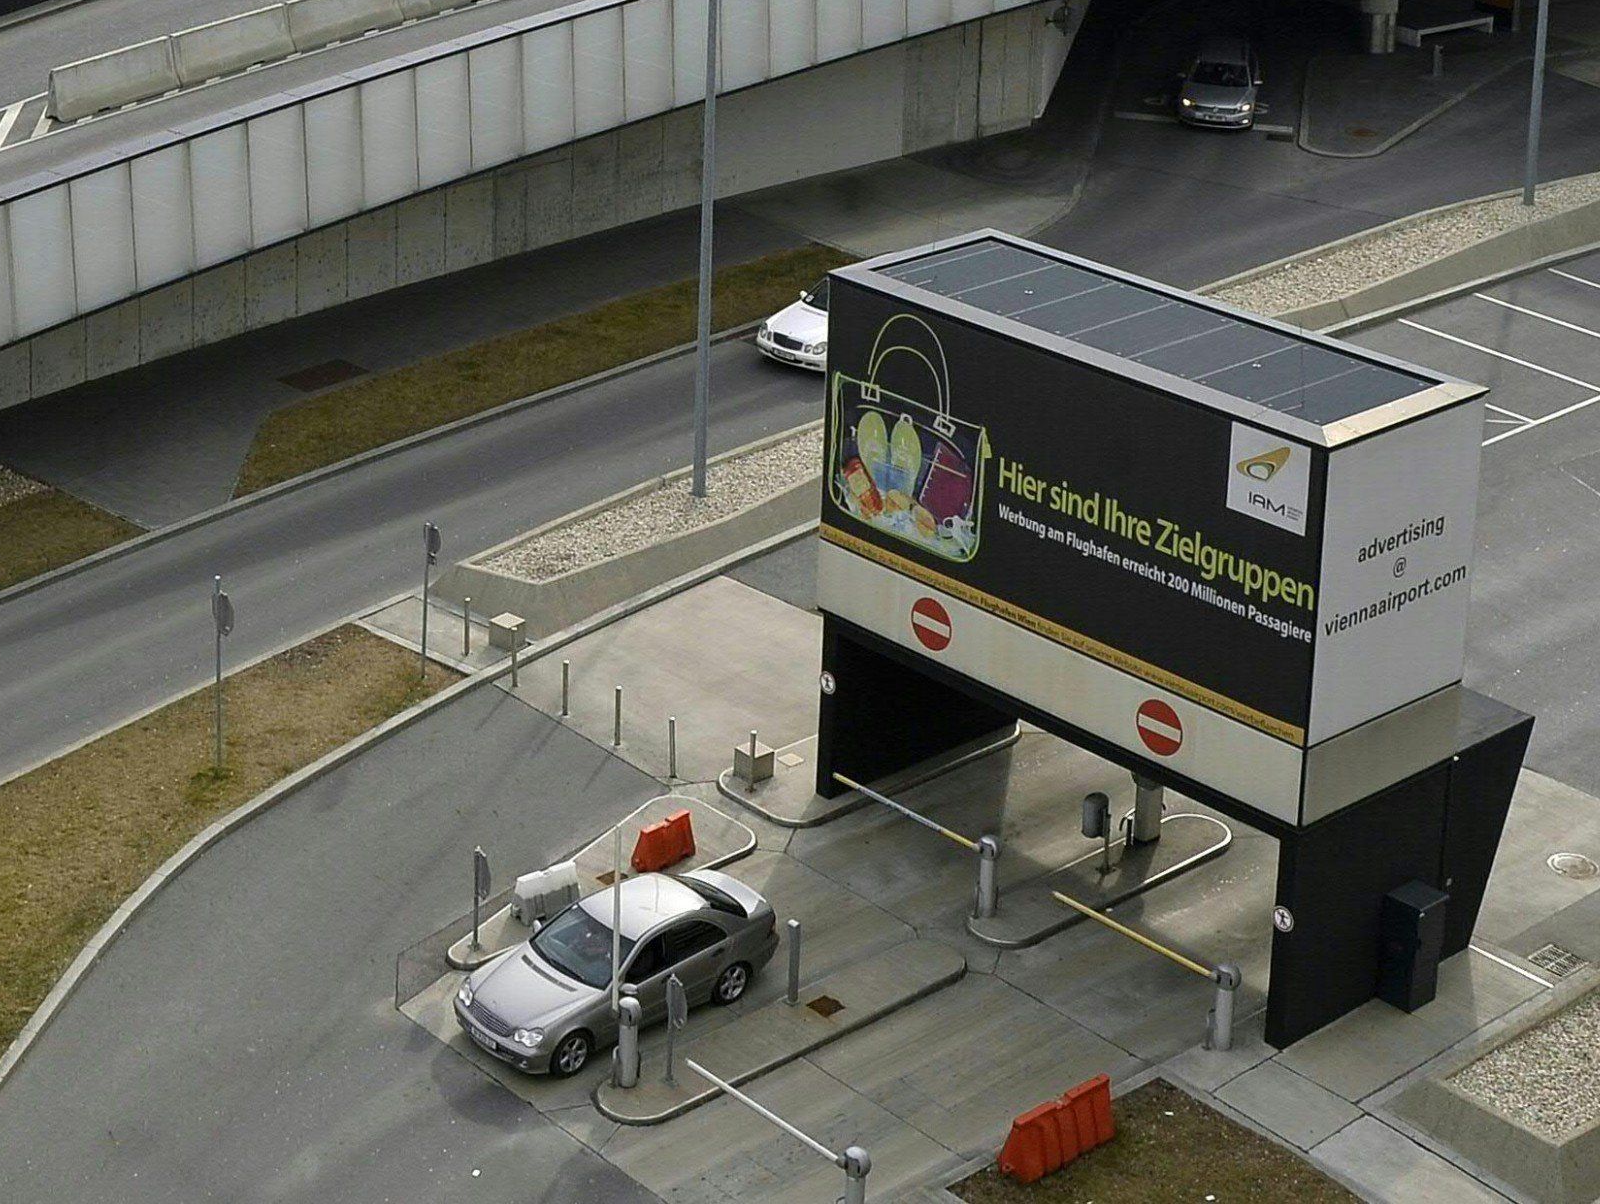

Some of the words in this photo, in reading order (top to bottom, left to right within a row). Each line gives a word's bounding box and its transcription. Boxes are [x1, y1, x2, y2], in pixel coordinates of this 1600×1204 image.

[1248, 490, 1286, 517] IAM
[999, 456, 1047, 504] Hier
[1050, 480, 1100, 527] sind
[1104, 497, 1151, 547] Ihre
[1154, 518, 1315, 612] Zielgruppen
[1357, 515, 1446, 564] advertising
[998, 502, 1046, 540] Werbung
[1047, 527, 1065, 544] am
[1066, 532, 1121, 566] Flughafen
[1122, 556, 1167, 585] erreicht
[1167, 572, 1190, 594] 200
[1190, 581, 1247, 618] Millionen
[1248, 603, 1313, 644] Passagiere
[1392, 556, 1407, 578] @
[1324, 564, 1467, 636] viennaairport.com
